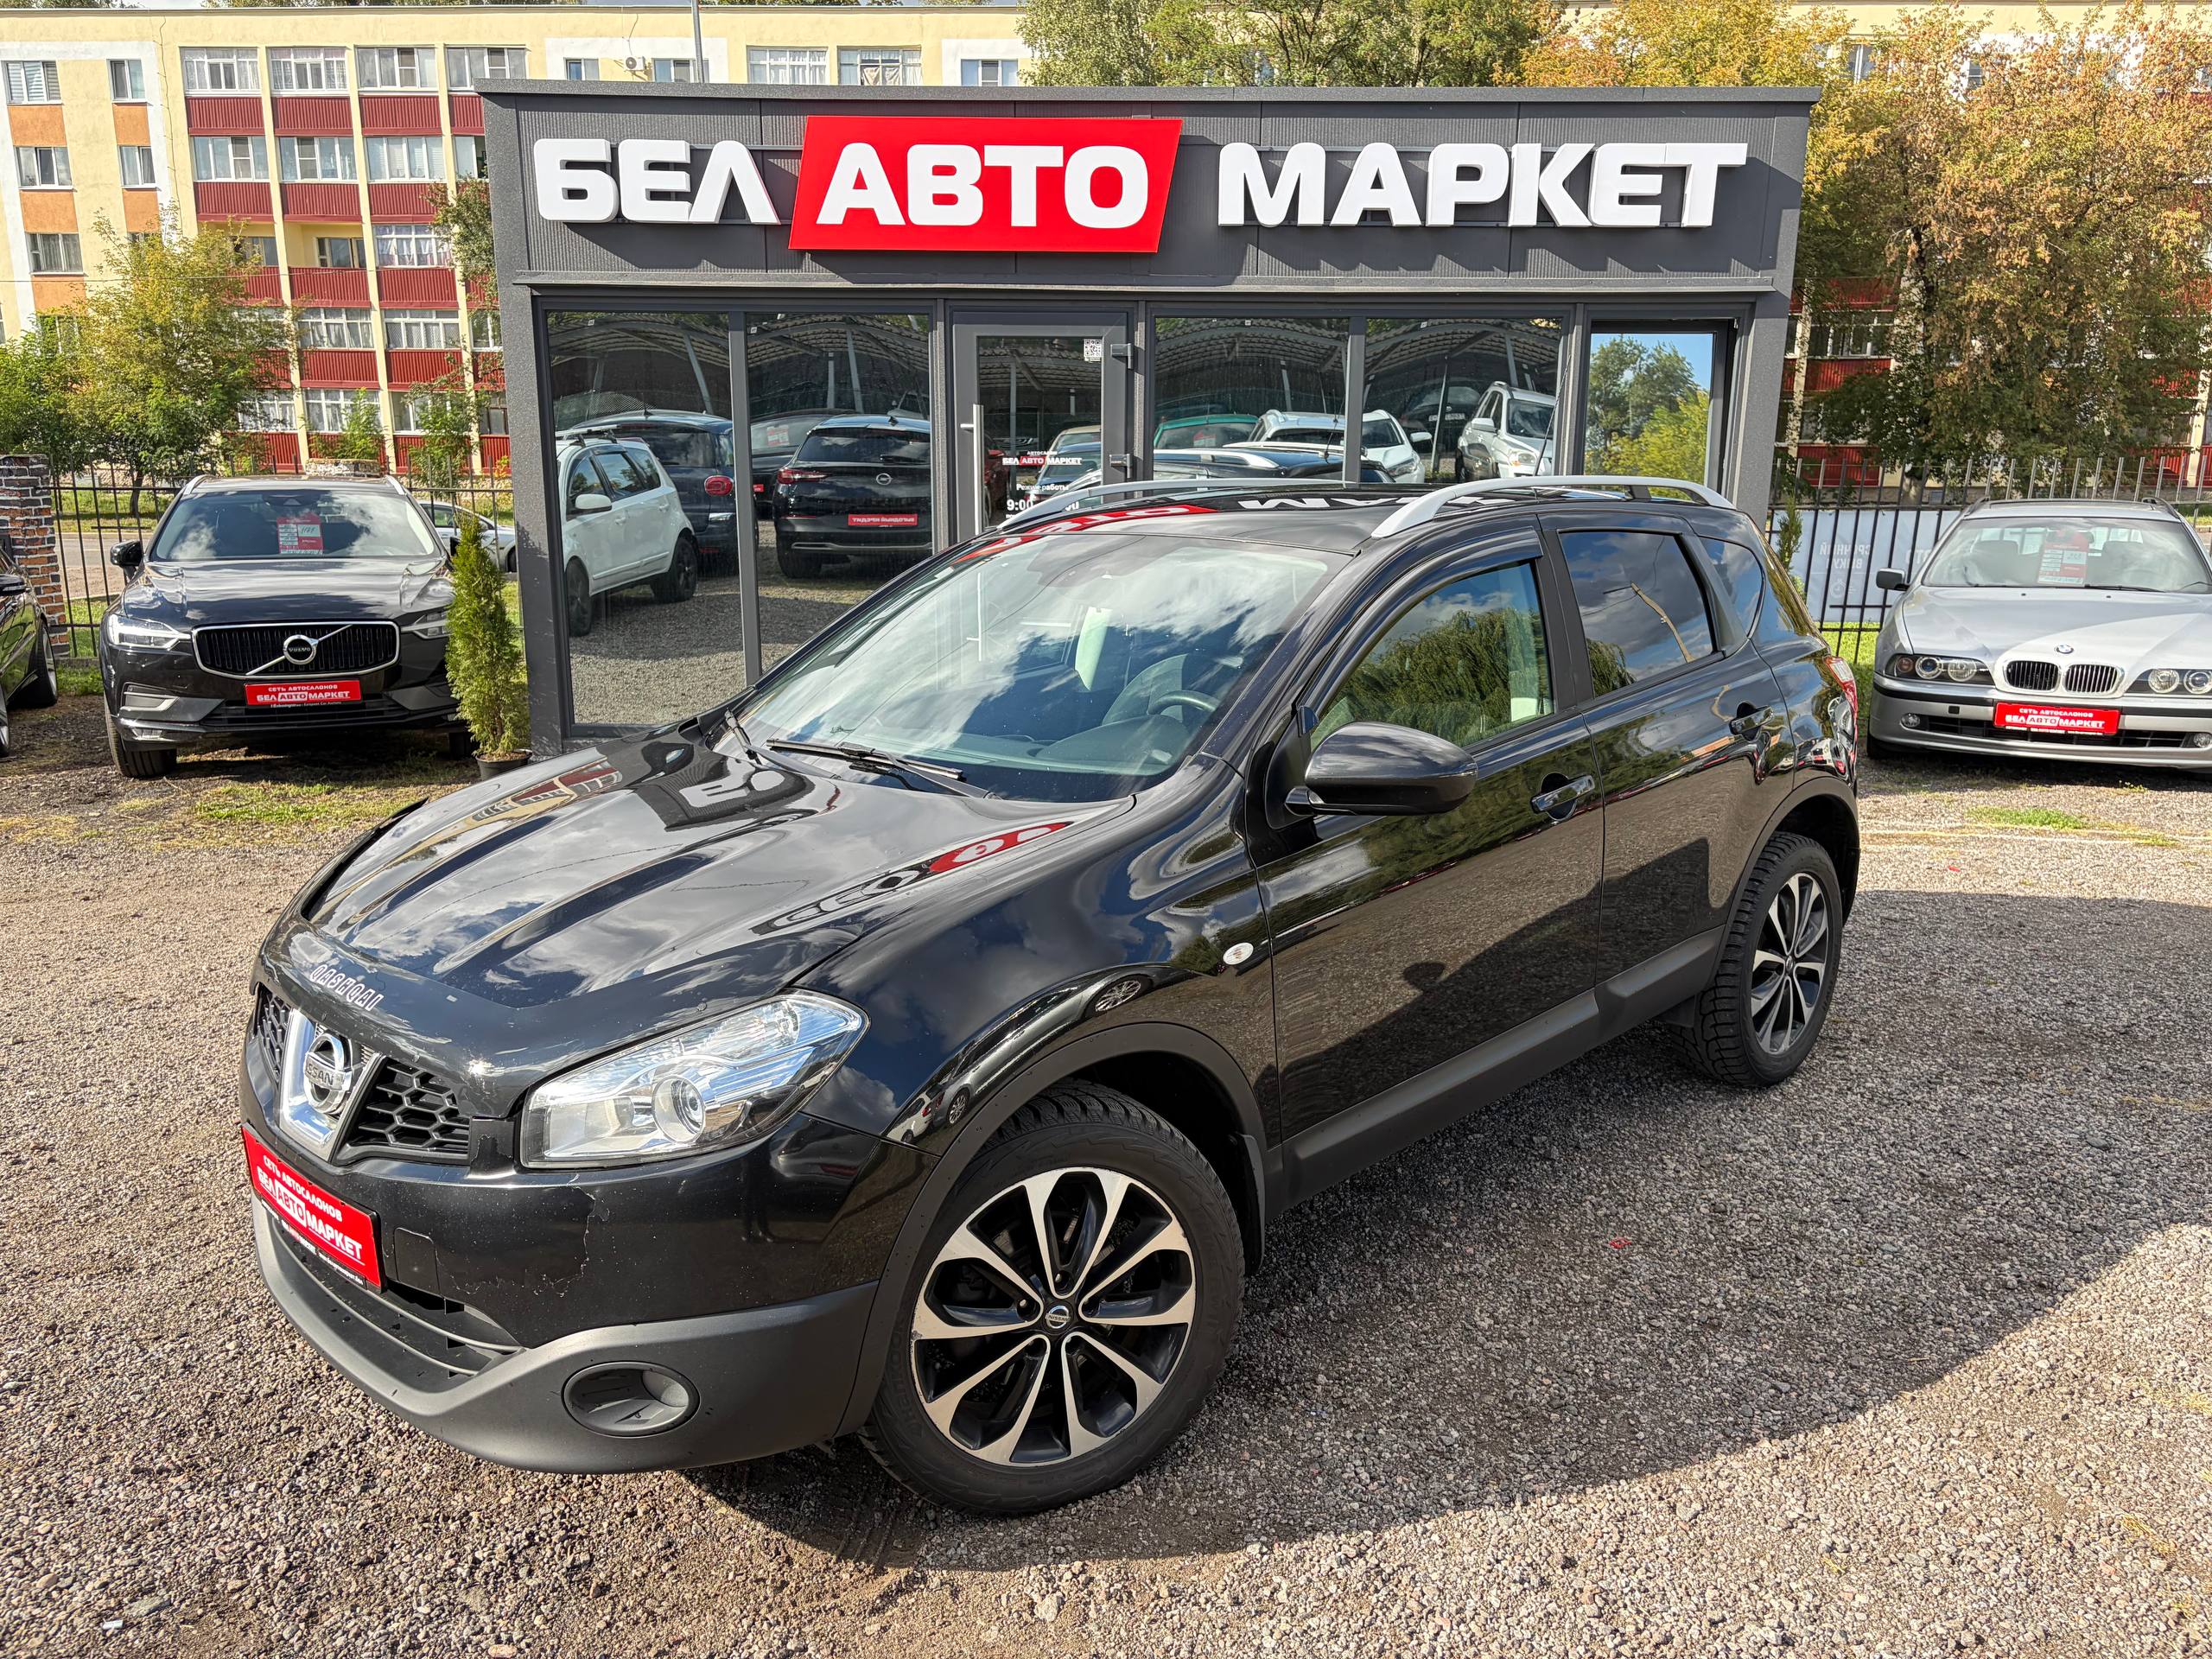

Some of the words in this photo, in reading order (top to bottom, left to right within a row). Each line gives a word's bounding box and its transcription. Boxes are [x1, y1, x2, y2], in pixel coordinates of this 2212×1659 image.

[534, 138, 780, 225] БЕЛ
[817, 143, 1149, 229] АВТО
[1218, 143, 1748, 227] МАРКЕТ
[1042, 483, 1069, 492] работы
[1007, 499, 1034, 511] 9:00
[279, 692, 307, 701] АВТО
[308, 690, 351, 700] МАРКЕТ
[2039, 709, 2094, 718] АВТОСАЛОНОВ
[2005, 714, 2027, 723] БЕЛ
[2029, 715, 2058, 725] АВТО
[2059, 718, 2105, 728] МАРКЕТ
[309, 963, 385, 1012] QASHQAI
[263, 1154, 282, 1179] СЕТЬ
[282, 1171, 343, 1223] АВТОСАЛОНОВ
[257, 1166, 276, 1198] БЕЛ
[276, 1187, 305, 1221] АВТО
[306, 1210, 363, 1260] МАРКЕТ
